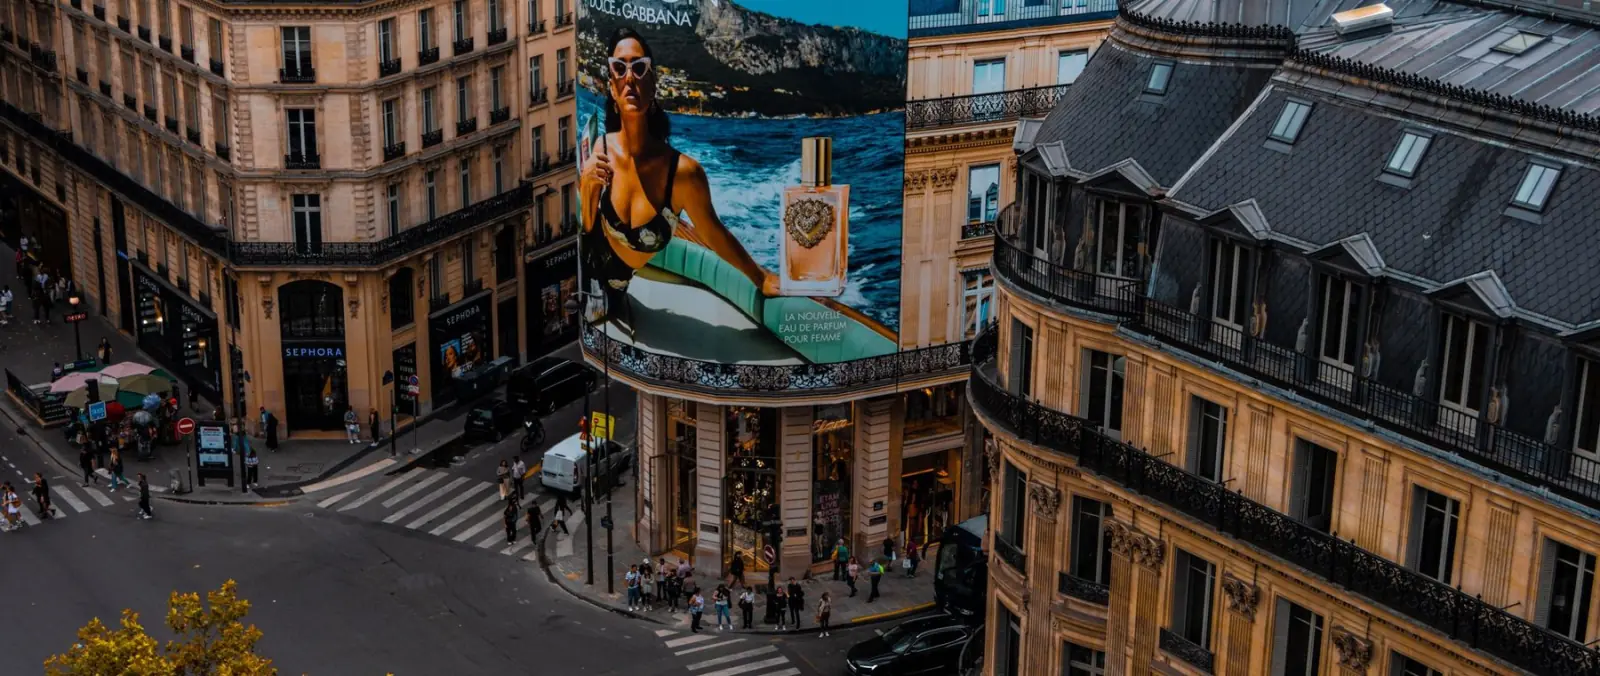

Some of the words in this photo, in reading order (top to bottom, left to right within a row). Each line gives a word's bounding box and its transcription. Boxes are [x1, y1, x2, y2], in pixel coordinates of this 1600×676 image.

[617, 8, 622, 16] &
[622, 3, 692, 27] GABBANA
[545, 248, 576, 268] SEPHORA
[446, 305, 480, 326] SEPHORA
[785, 313, 795, 321] LA
[797, 311, 841, 321] NOUVELLE
[778, 323, 797, 333] EAU
[799, 323, 811, 332] DE
[813, 321, 847, 331] PARFUM
[784, 334, 808, 344] POUR
[811, 332, 841, 342] FEMME
[285, 347, 342, 357] SEPHORA
